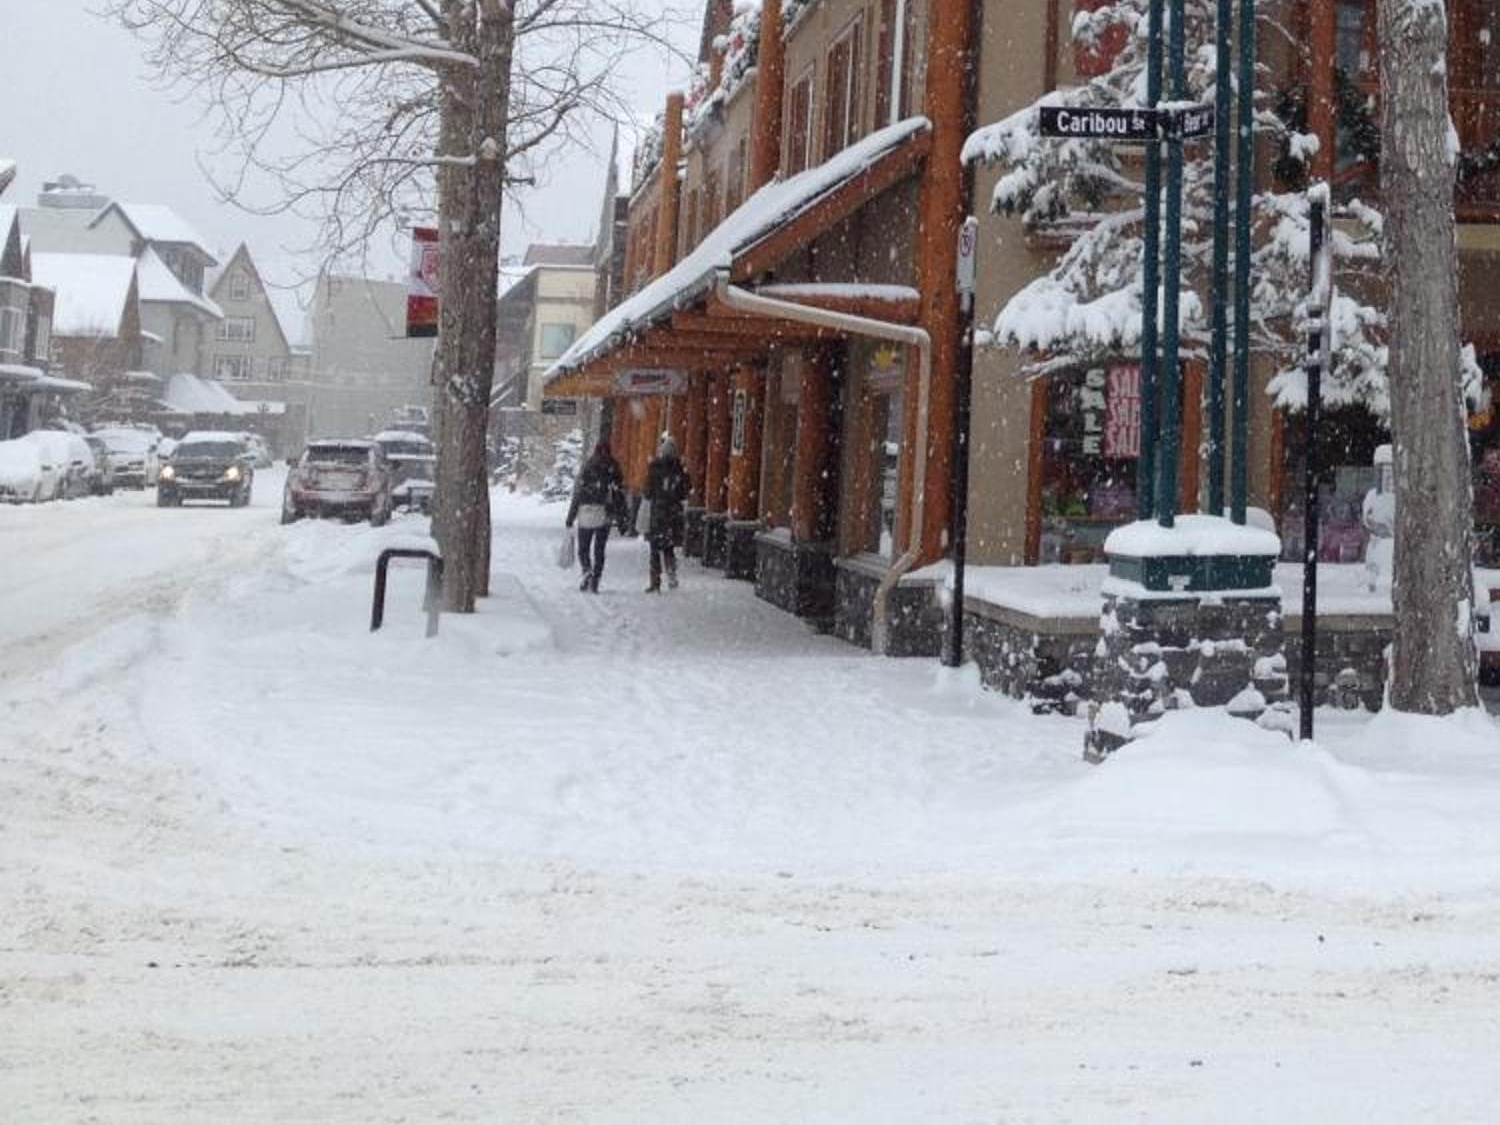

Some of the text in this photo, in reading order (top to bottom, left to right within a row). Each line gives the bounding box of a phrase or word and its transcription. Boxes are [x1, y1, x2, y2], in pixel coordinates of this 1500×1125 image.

[1056, 110, 1127, 134] Caribou
[1109, 368, 1141, 397] SAL
[1080, 368, 1106, 454] SALE
[1107, 398, 1141, 426] SAL
[1104, 426, 1141, 456] SAL
